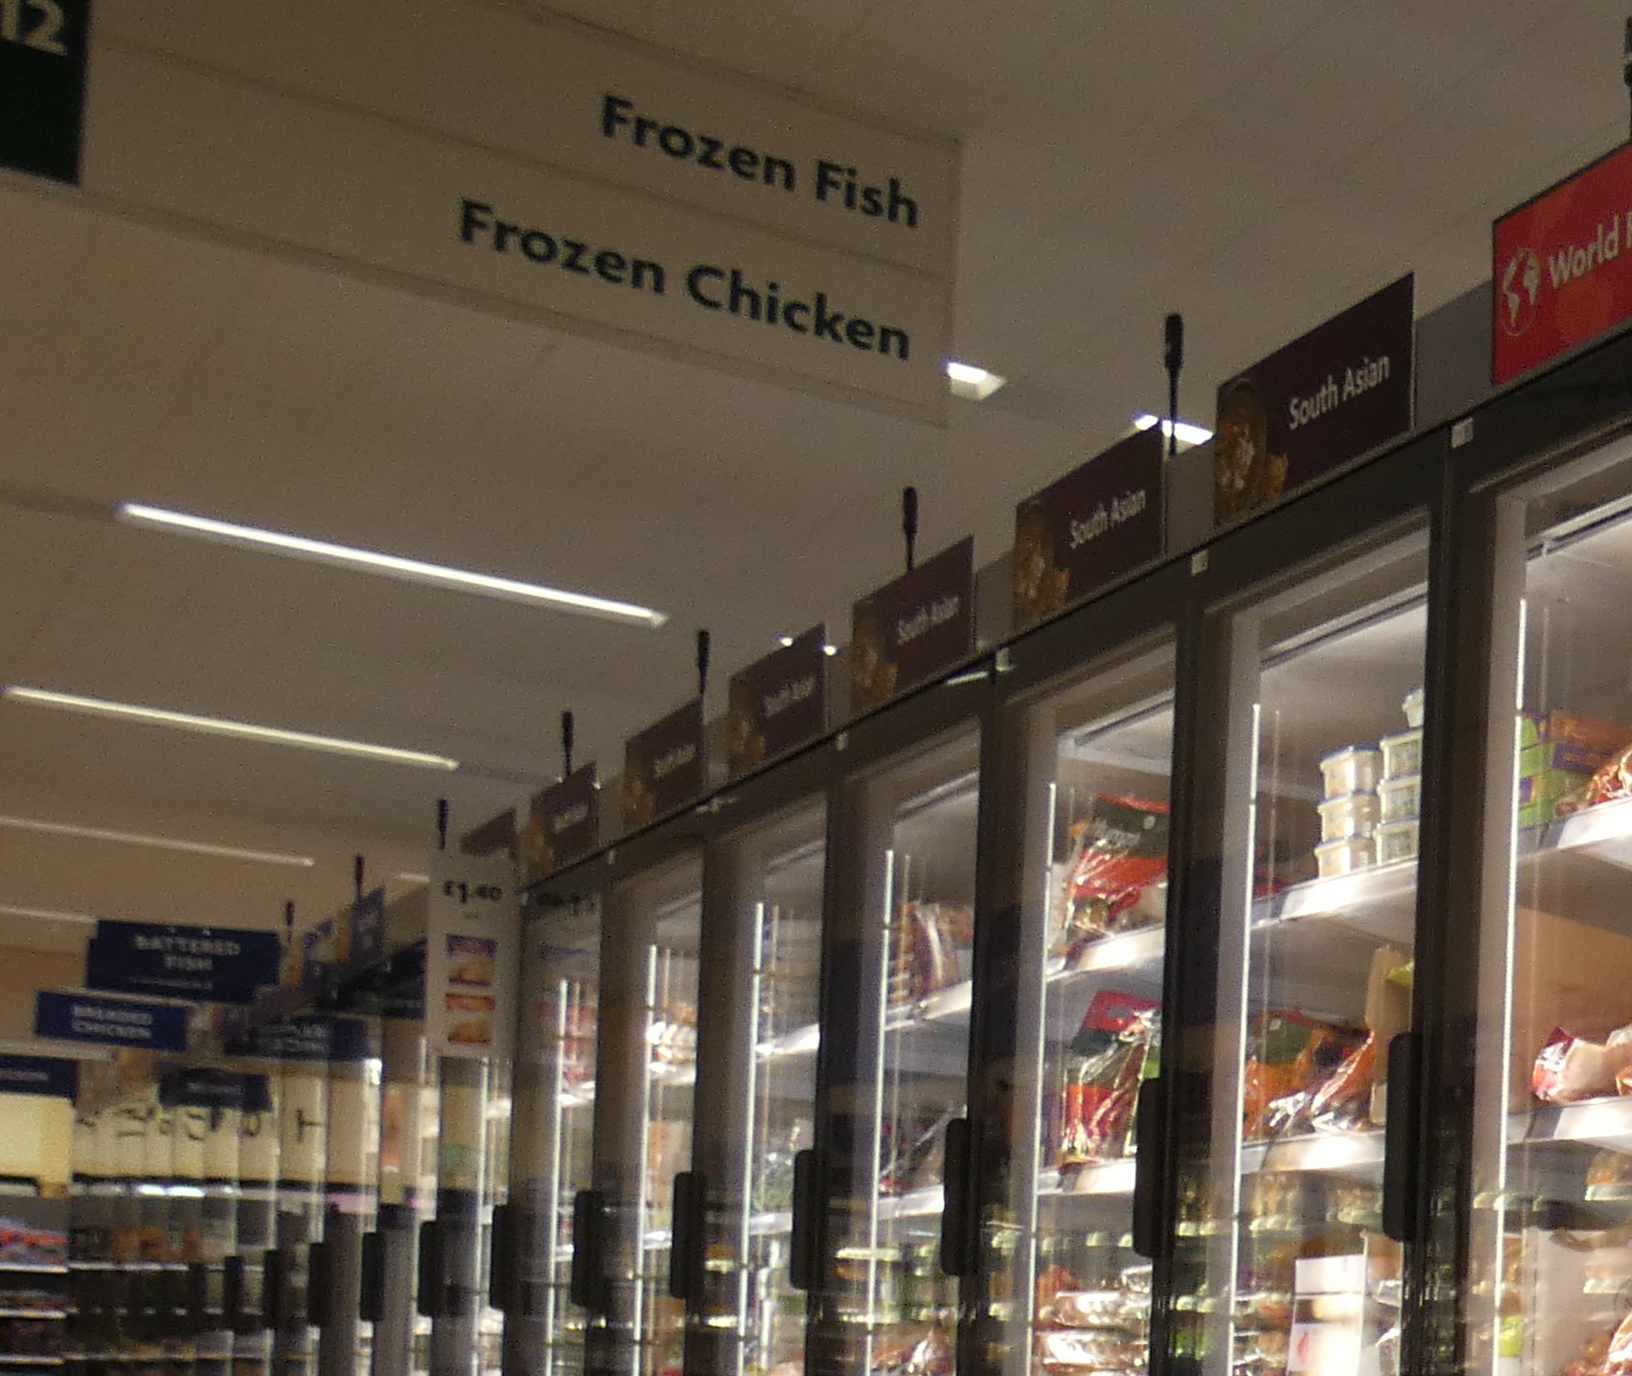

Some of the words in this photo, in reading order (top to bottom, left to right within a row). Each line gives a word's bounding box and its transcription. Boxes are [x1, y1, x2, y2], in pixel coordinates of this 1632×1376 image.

[602, 95, 796, 191] Frozen
[816, 158, 918, 228] Fish
[457, 198, 665, 294] Frozen
[685, 264, 909, 360] Chicken
[1549, 214, 1619, 288] World
[1289, 374, 1339, 430] South
[1343, 355, 1389, 402] Asian
[1069, 508, 1107, 549] South
[1109, 488, 1146, 528] Asian
